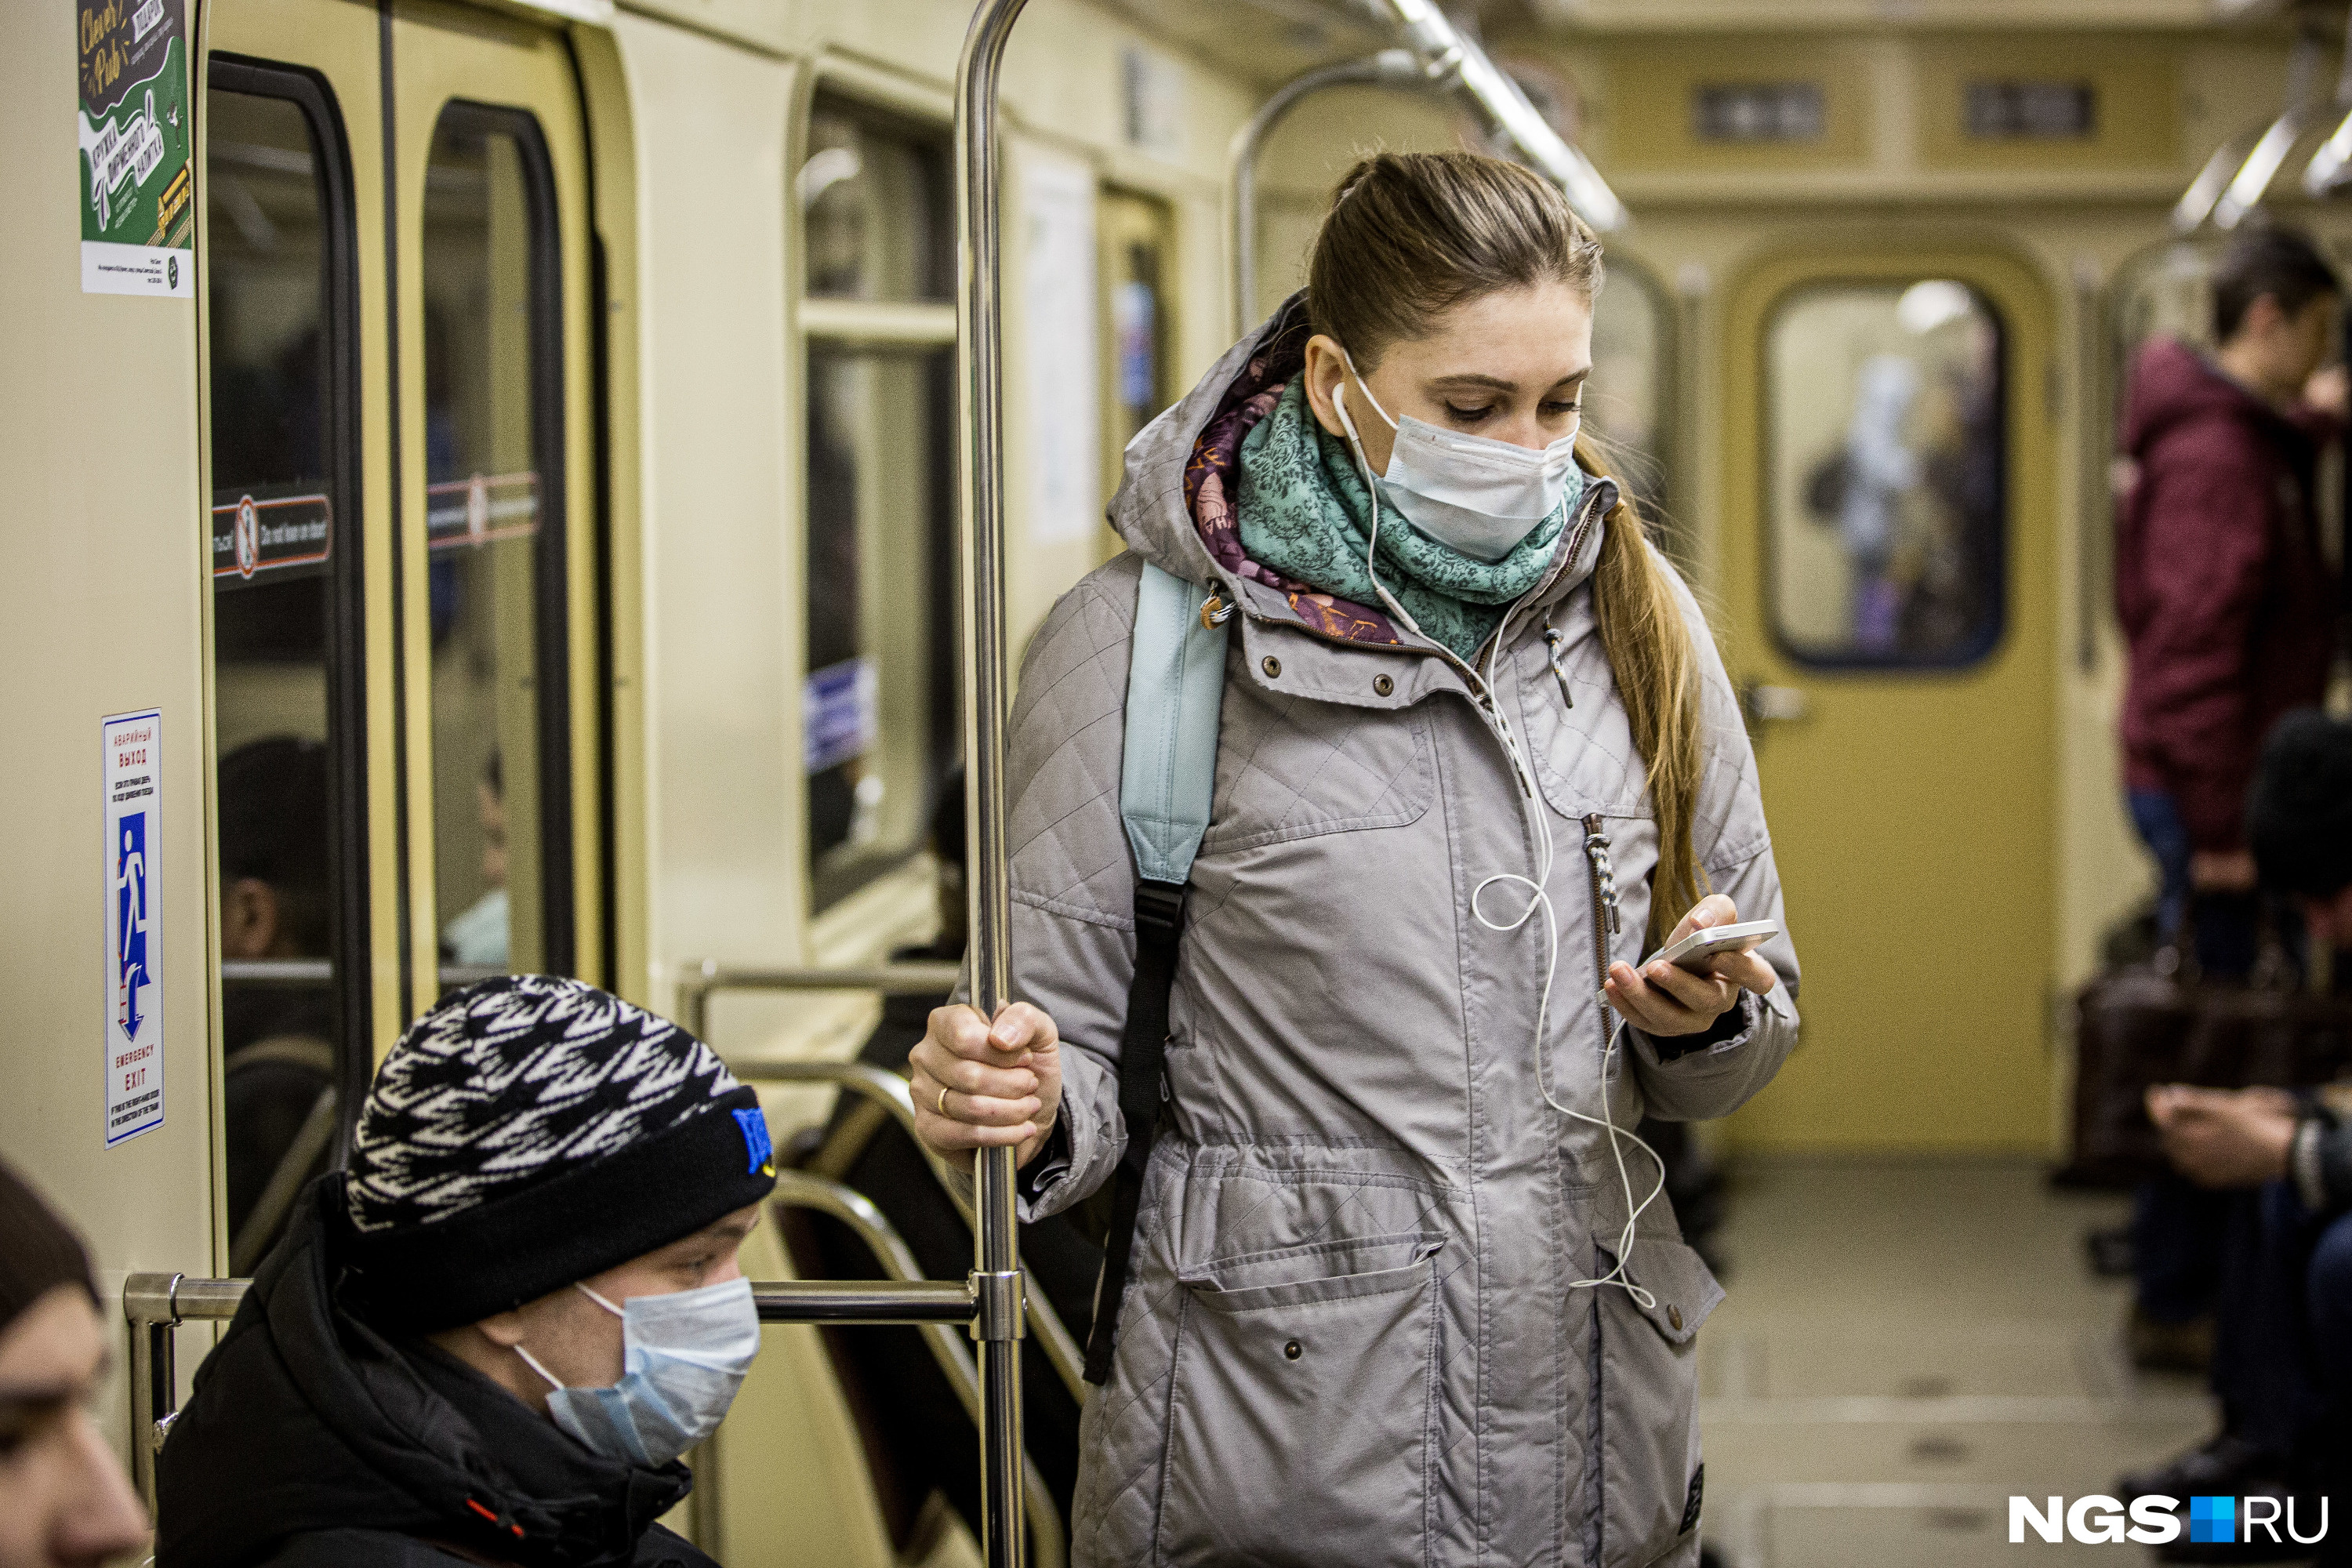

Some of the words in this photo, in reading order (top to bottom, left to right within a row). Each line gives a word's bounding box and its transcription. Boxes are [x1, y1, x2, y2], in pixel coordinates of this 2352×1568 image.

[114, 727, 152, 747] АВАРИЙНЫЙ
[119, 748, 147, 768] ВЫХОД
[116, 1044, 154, 1069] EMERGENCY
[125, 1068, 146, 1091] EXIT
